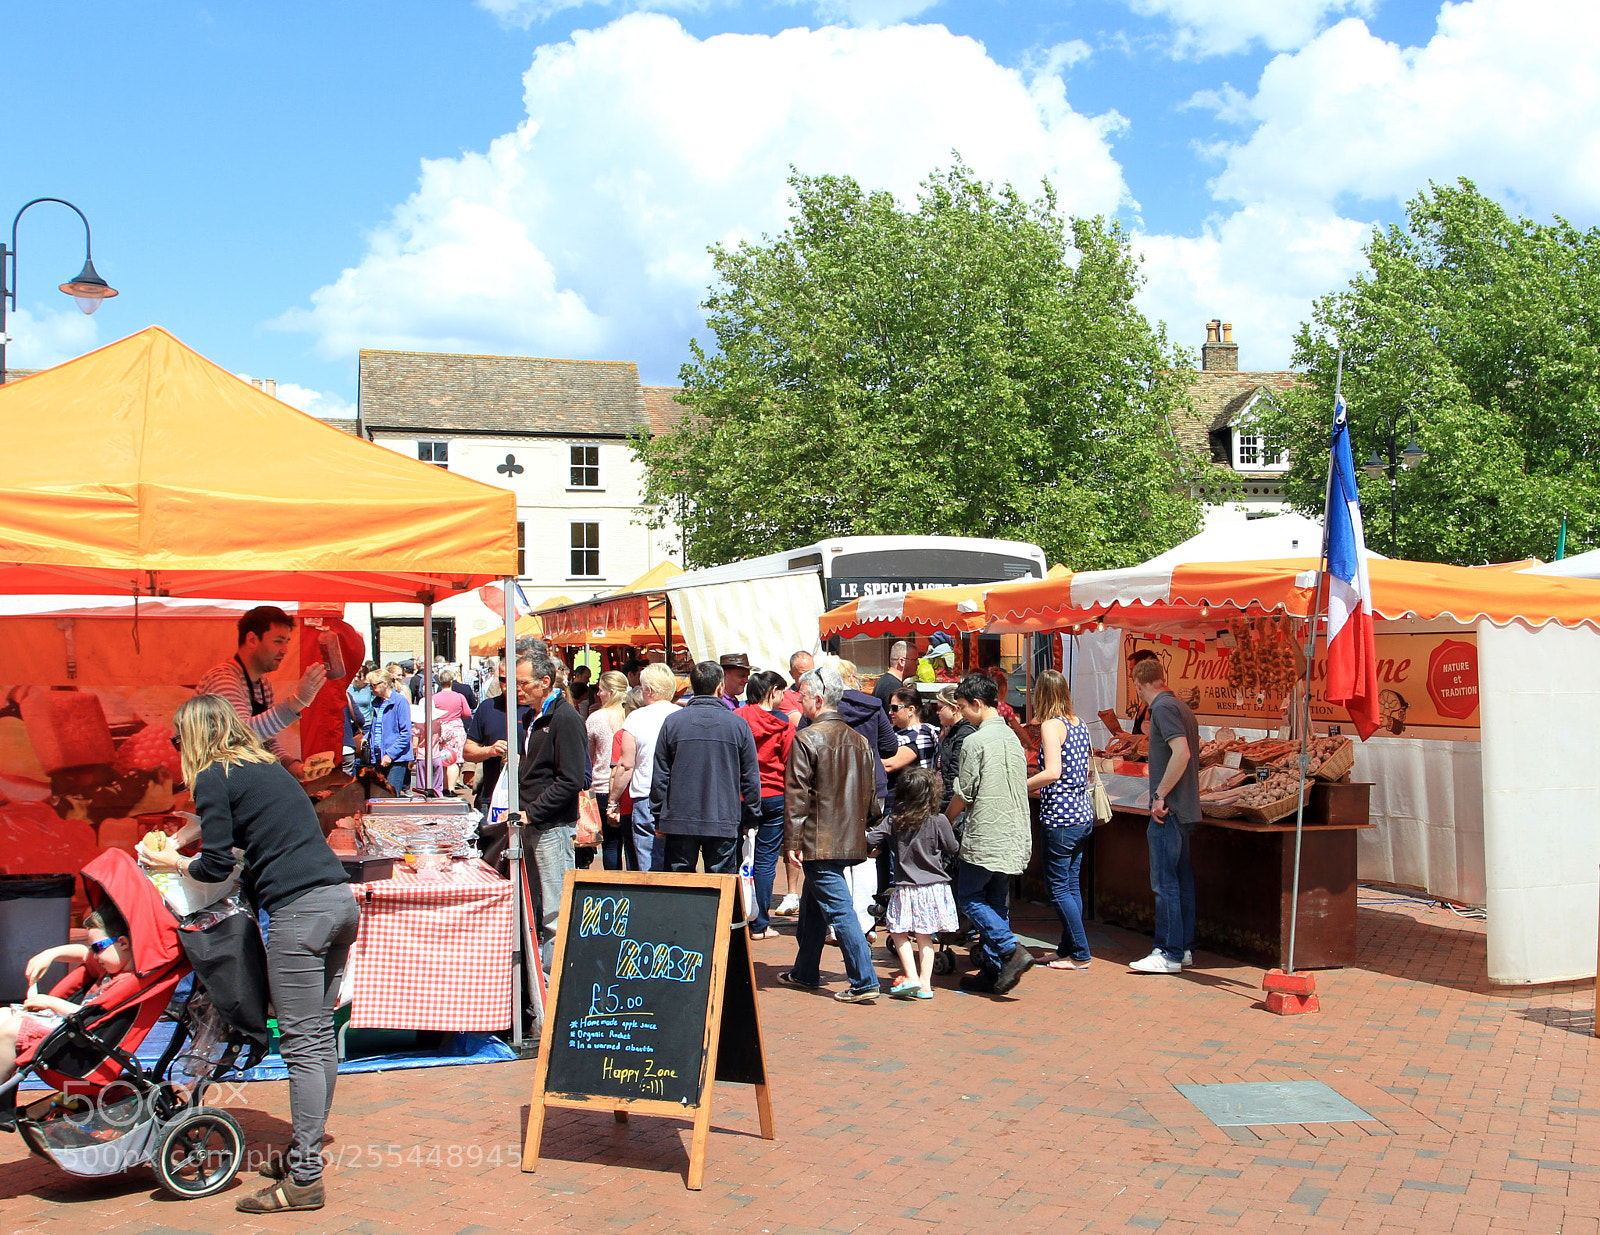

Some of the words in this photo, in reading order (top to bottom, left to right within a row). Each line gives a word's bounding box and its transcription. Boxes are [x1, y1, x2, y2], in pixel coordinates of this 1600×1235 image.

[839, 583, 858, 597] LE
[863, 582, 952, 597] SPECIALI
[1179, 648, 1230, 681] Prod
[1442, 661, 1470, 673] NATURE
[1453, 674, 1462, 684] et
[1440, 686, 1477, 698] TRADITION
[1216, 702, 1252, 711] RESPECT
[1254, 703, 1265, 712] DE
[1268, 704, 1279, 713] LA
[580, 896, 630, 937] HOG
[616, 939, 703, 982] ROAST
[588, 983, 643, 1015] £5.00
[622, 1019, 638, 1031] apple
[640, 1022, 658, 1031] sauce
[577, 1030, 605, 1042] Organic
[577, 1040, 585, 1050] In
[594, 1042, 621, 1051] warmed
[602, 1056, 640, 1084] Happy
[644, 1059, 679, 1078] Zone
